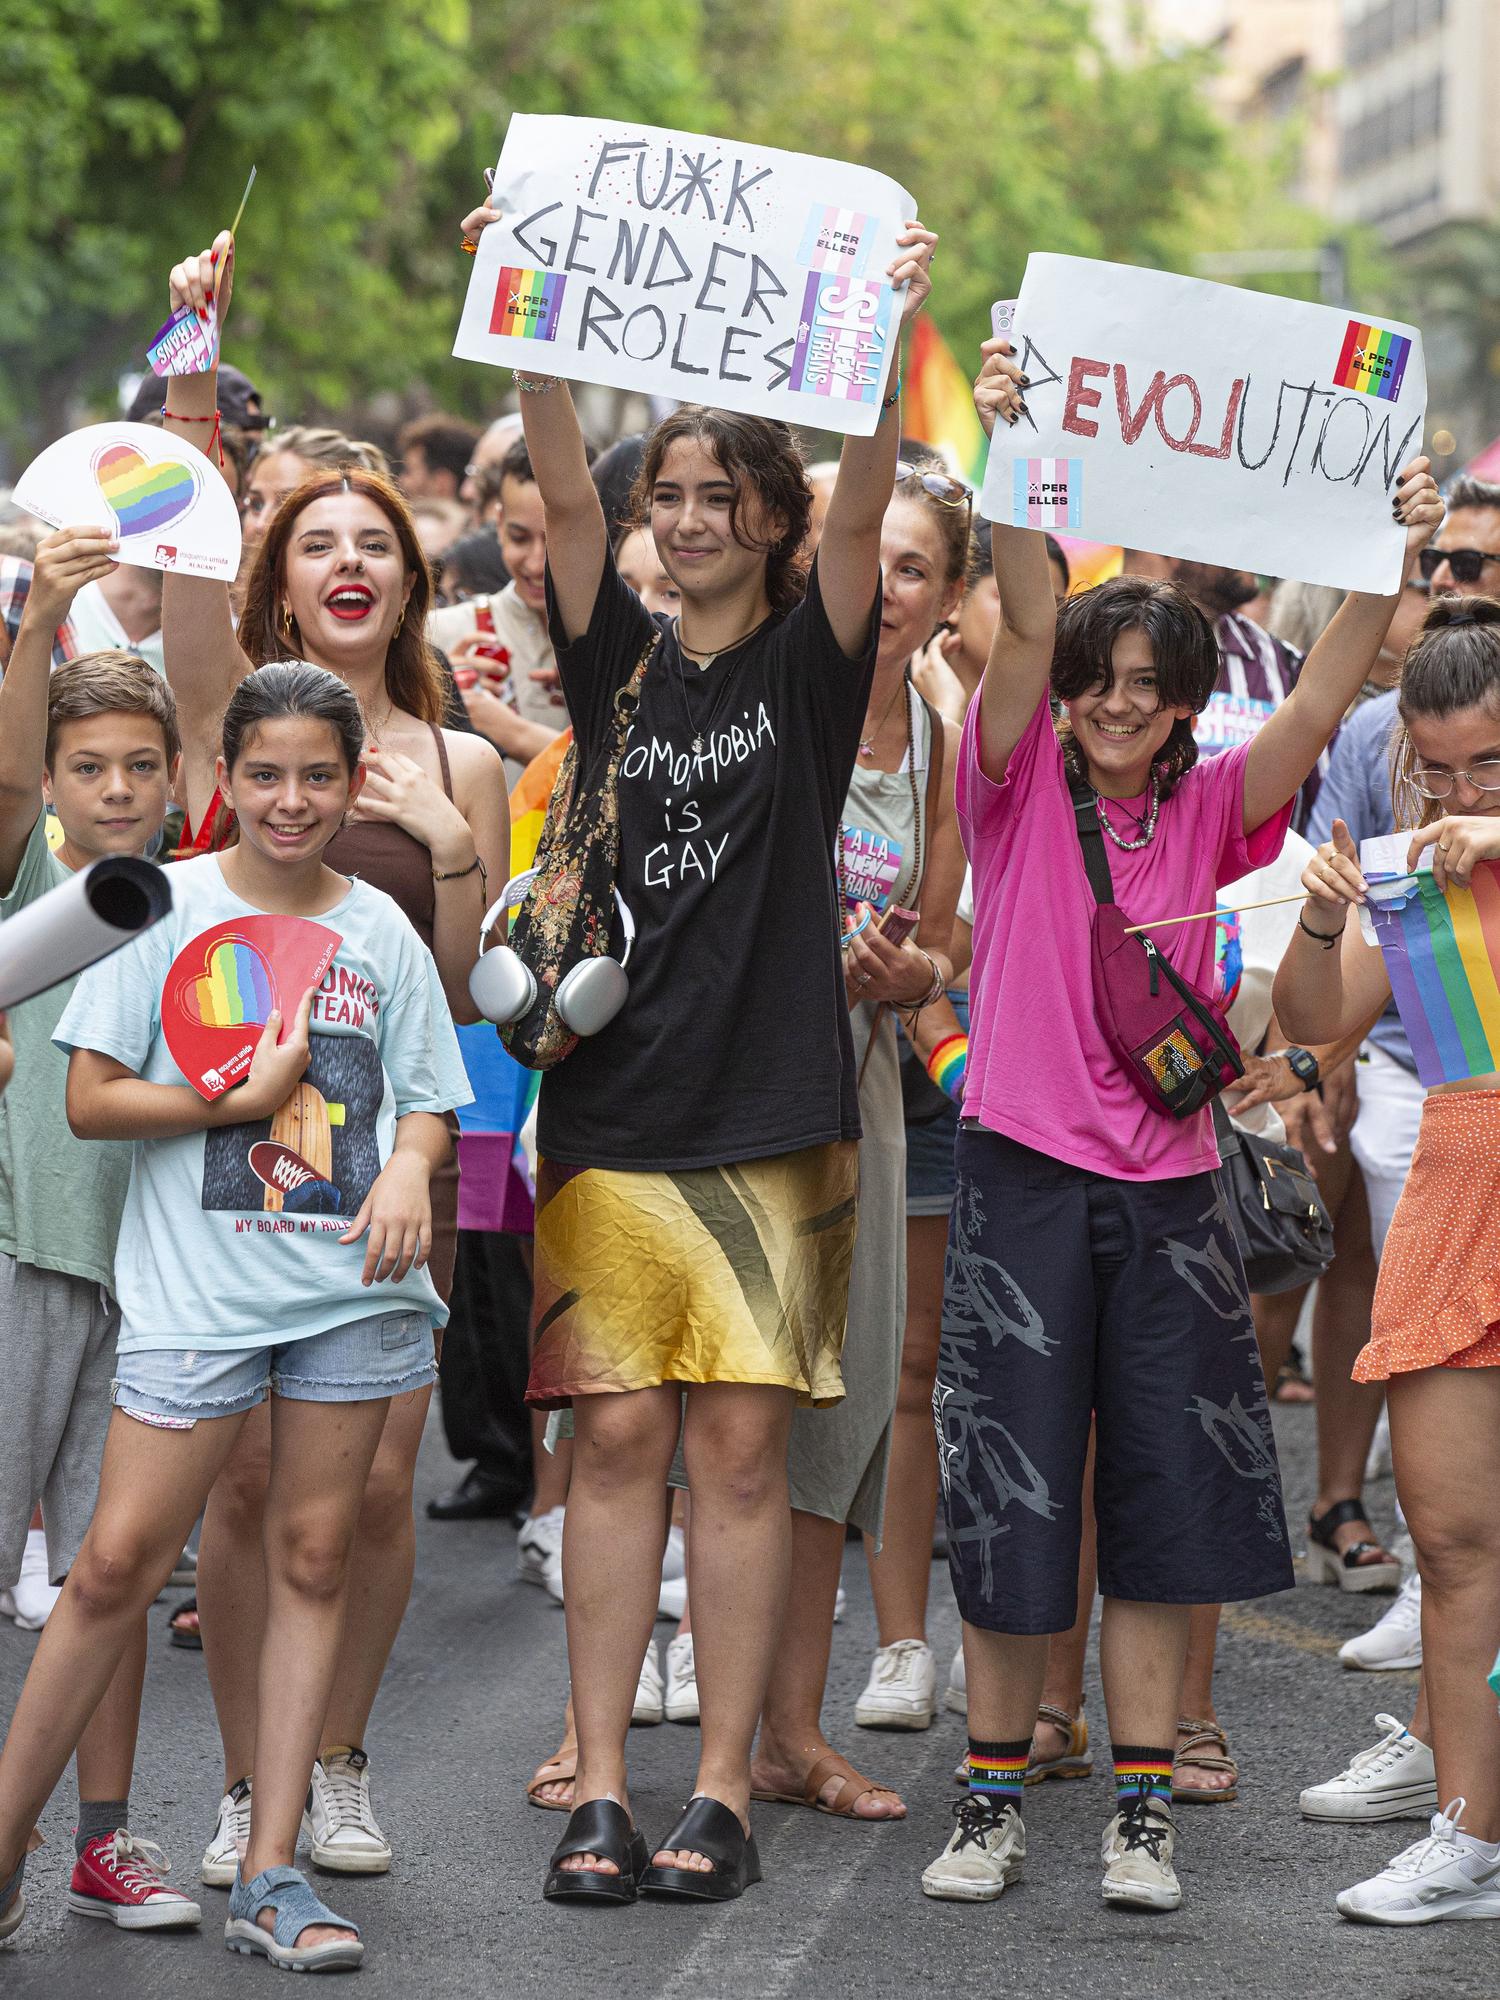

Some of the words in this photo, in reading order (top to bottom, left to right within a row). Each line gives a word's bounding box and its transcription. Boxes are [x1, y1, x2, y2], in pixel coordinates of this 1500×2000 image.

[816, 240, 857, 256] ELLES
[833, 231, 859, 245] PER
[512, 202, 787, 324] GENDER
[523, 295, 549, 306] PER
[508, 306, 547, 319] ELLES
[577, 286, 796, 391] ROLES
[859, 339, 882, 355] A
[806, 332, 835, 385] TRANS
[831, 344, 857, 382] LEY
[1353, 360, 1391, 378] ELLES
[1368, 353, 1393, 367] PER
[853, 360, 880, 386] LA
[1042, 484, 1067, 492] PER
[1028, 497, 1068, 505] ELLES
[850, 829, 863, 851] A
[868, 835, 889, 860] LA
[645, 832, 729, 889] GAY
[849, 852, 884, 880] LEY
[845, 873, 882, 901] RANS
[313, 995, 365, 1028] TEAM
[235, 1219, 252, 1233] MY
[257, 1220, 295, 1233] BOARD
[300, 1221, 316, 1233] MY
[321, 1220, 353, 1232] RULE
